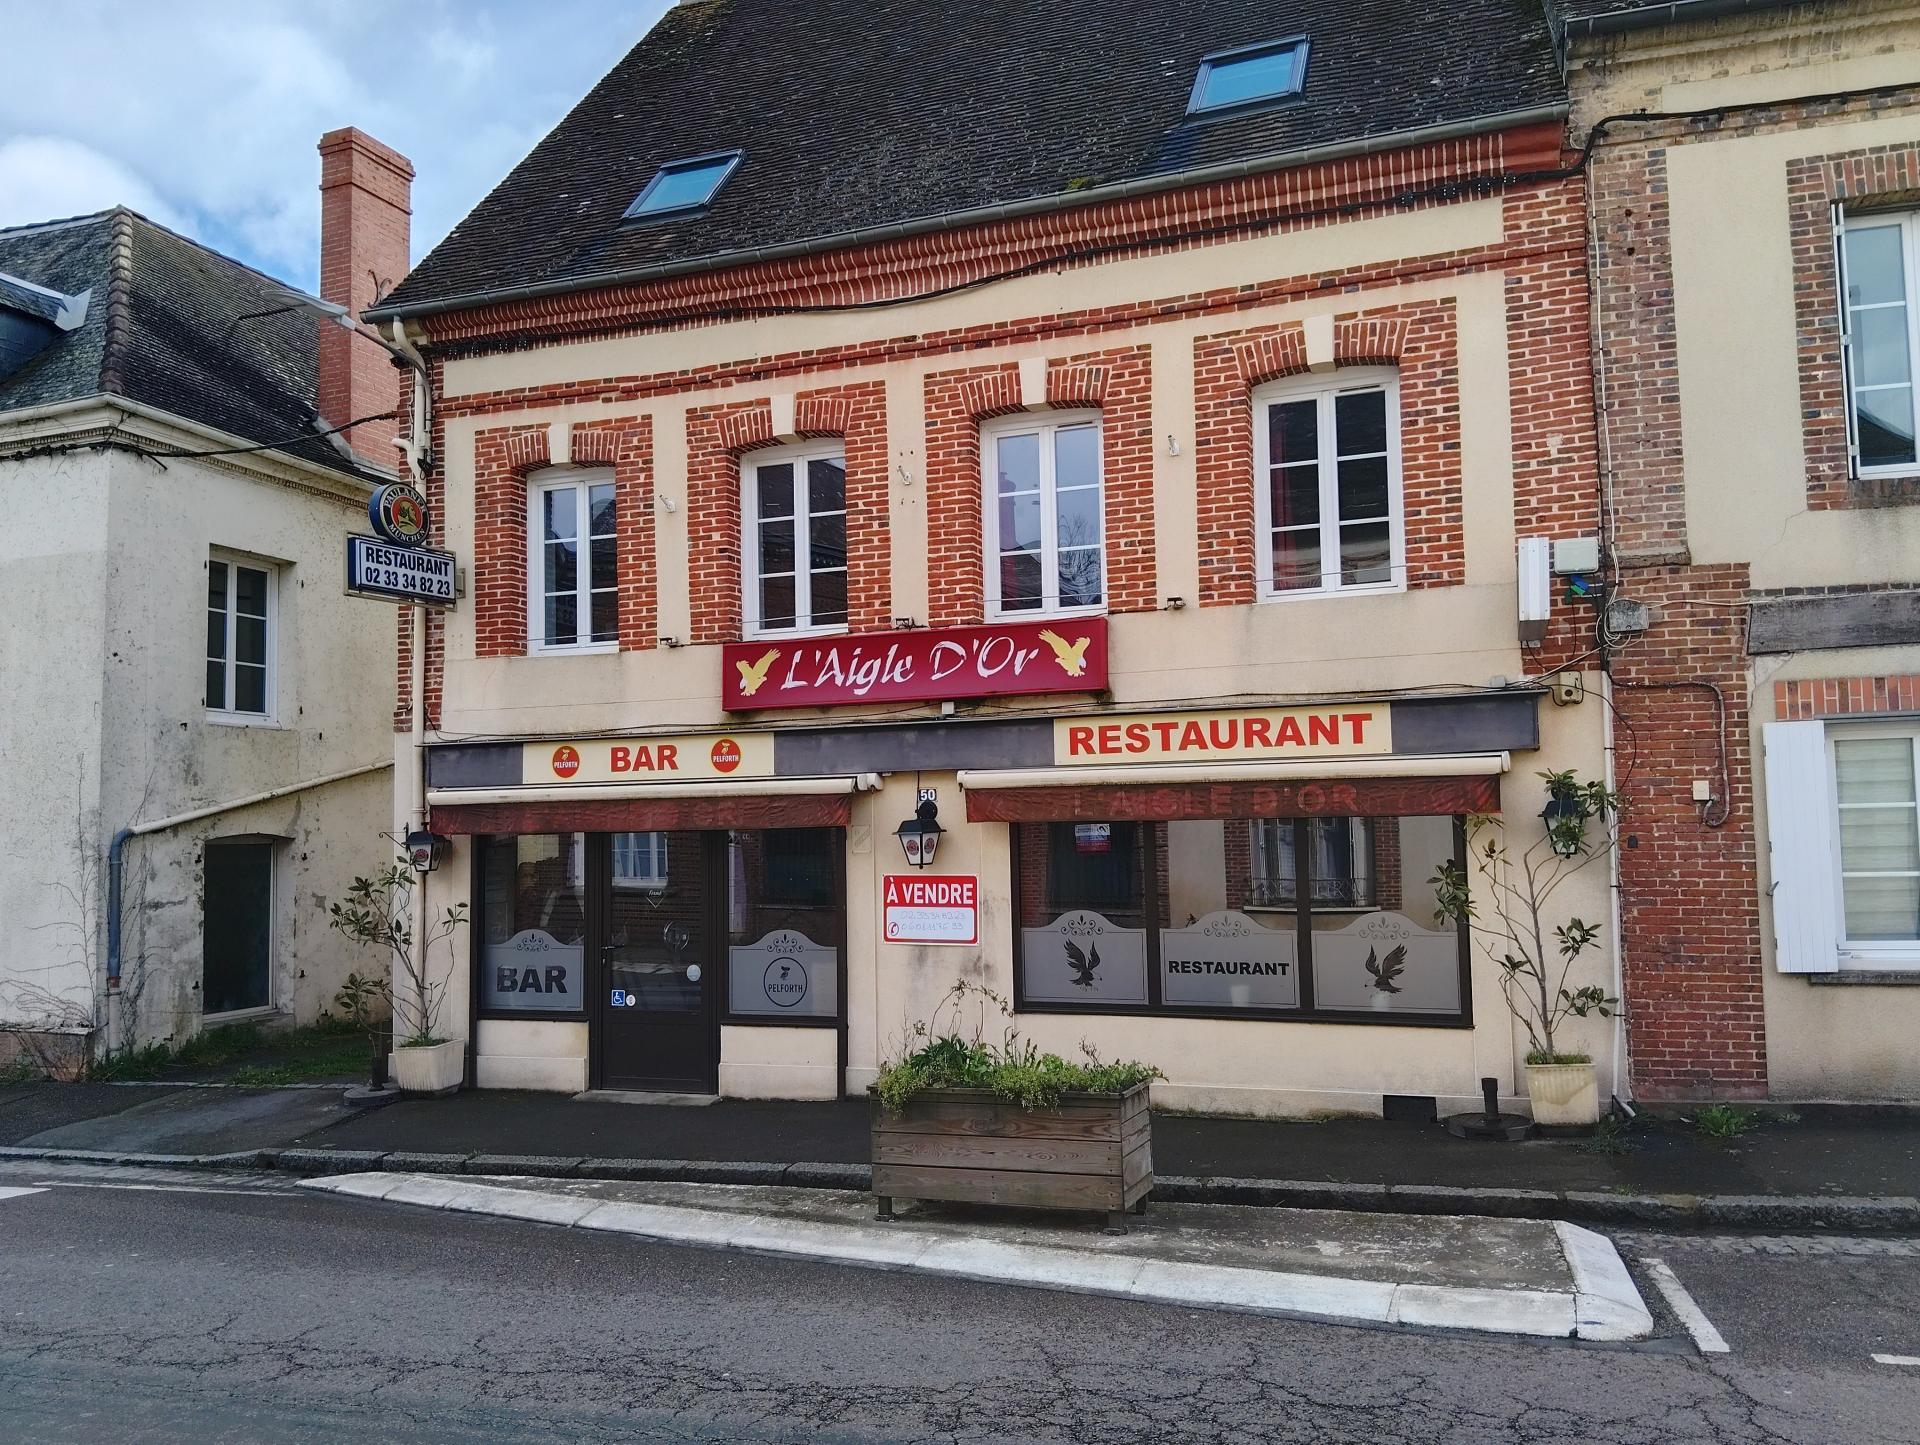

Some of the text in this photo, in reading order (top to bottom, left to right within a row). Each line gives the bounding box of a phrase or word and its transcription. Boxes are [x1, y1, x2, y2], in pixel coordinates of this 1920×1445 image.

[384, 487, 427, 513] PAULANER
[365, 545, 450, 577] RESTAURANT
[365, 566, 451, 596] 02 33 34 82 23
[779, 636, 1040, 696] L'Aigle D'Or
[1068, 713, 1373, 756] RESTAURANT
[553, 760, 578, 769] PELFORTH
[610, 744, 679, 773] BAR
[712, 753, 740, 763] PELFORTH
[920, 789, 936, 801] 50
[1252, 783, 1360, 815] D'OR
[886, 876, 974, 905] À VENDRE
[496, 965, 568, 994] BAR
[1168, 960, 1290, 977] RESTAURANT
[767, 983, 804, 994] PELFORTH
